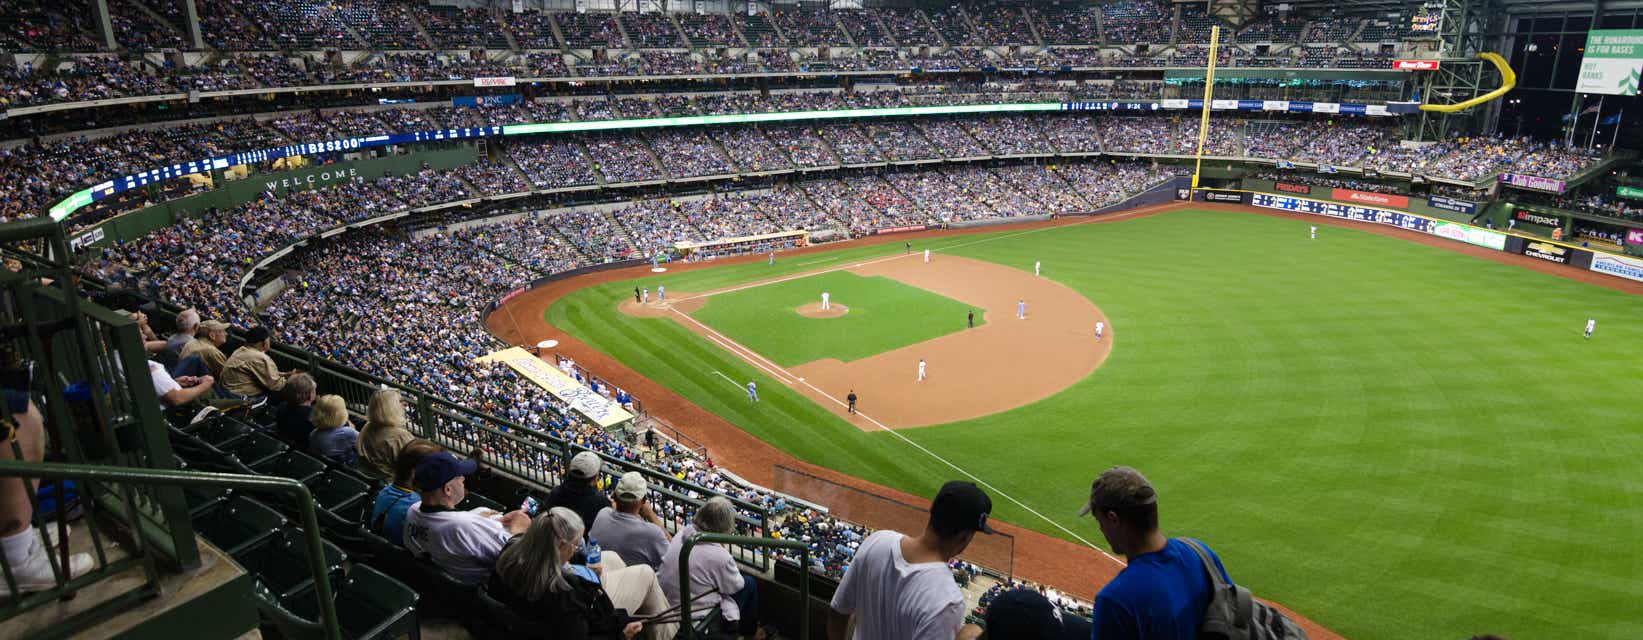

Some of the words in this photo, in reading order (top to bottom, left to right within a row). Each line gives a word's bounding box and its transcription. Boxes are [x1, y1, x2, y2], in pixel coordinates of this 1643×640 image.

[484, 96, 503, 104] PNC
[267, 168, 357, 190] WELCOME
[1512, 174, 1527, 187] Club
[1529, 177, 1560, 192] Goodwill
[1276, 183, 1309, 193] FRIDAYS
[1526, 212, 1559, 226] impact
[1526, 251, 1565, 264] CHEVROLET
